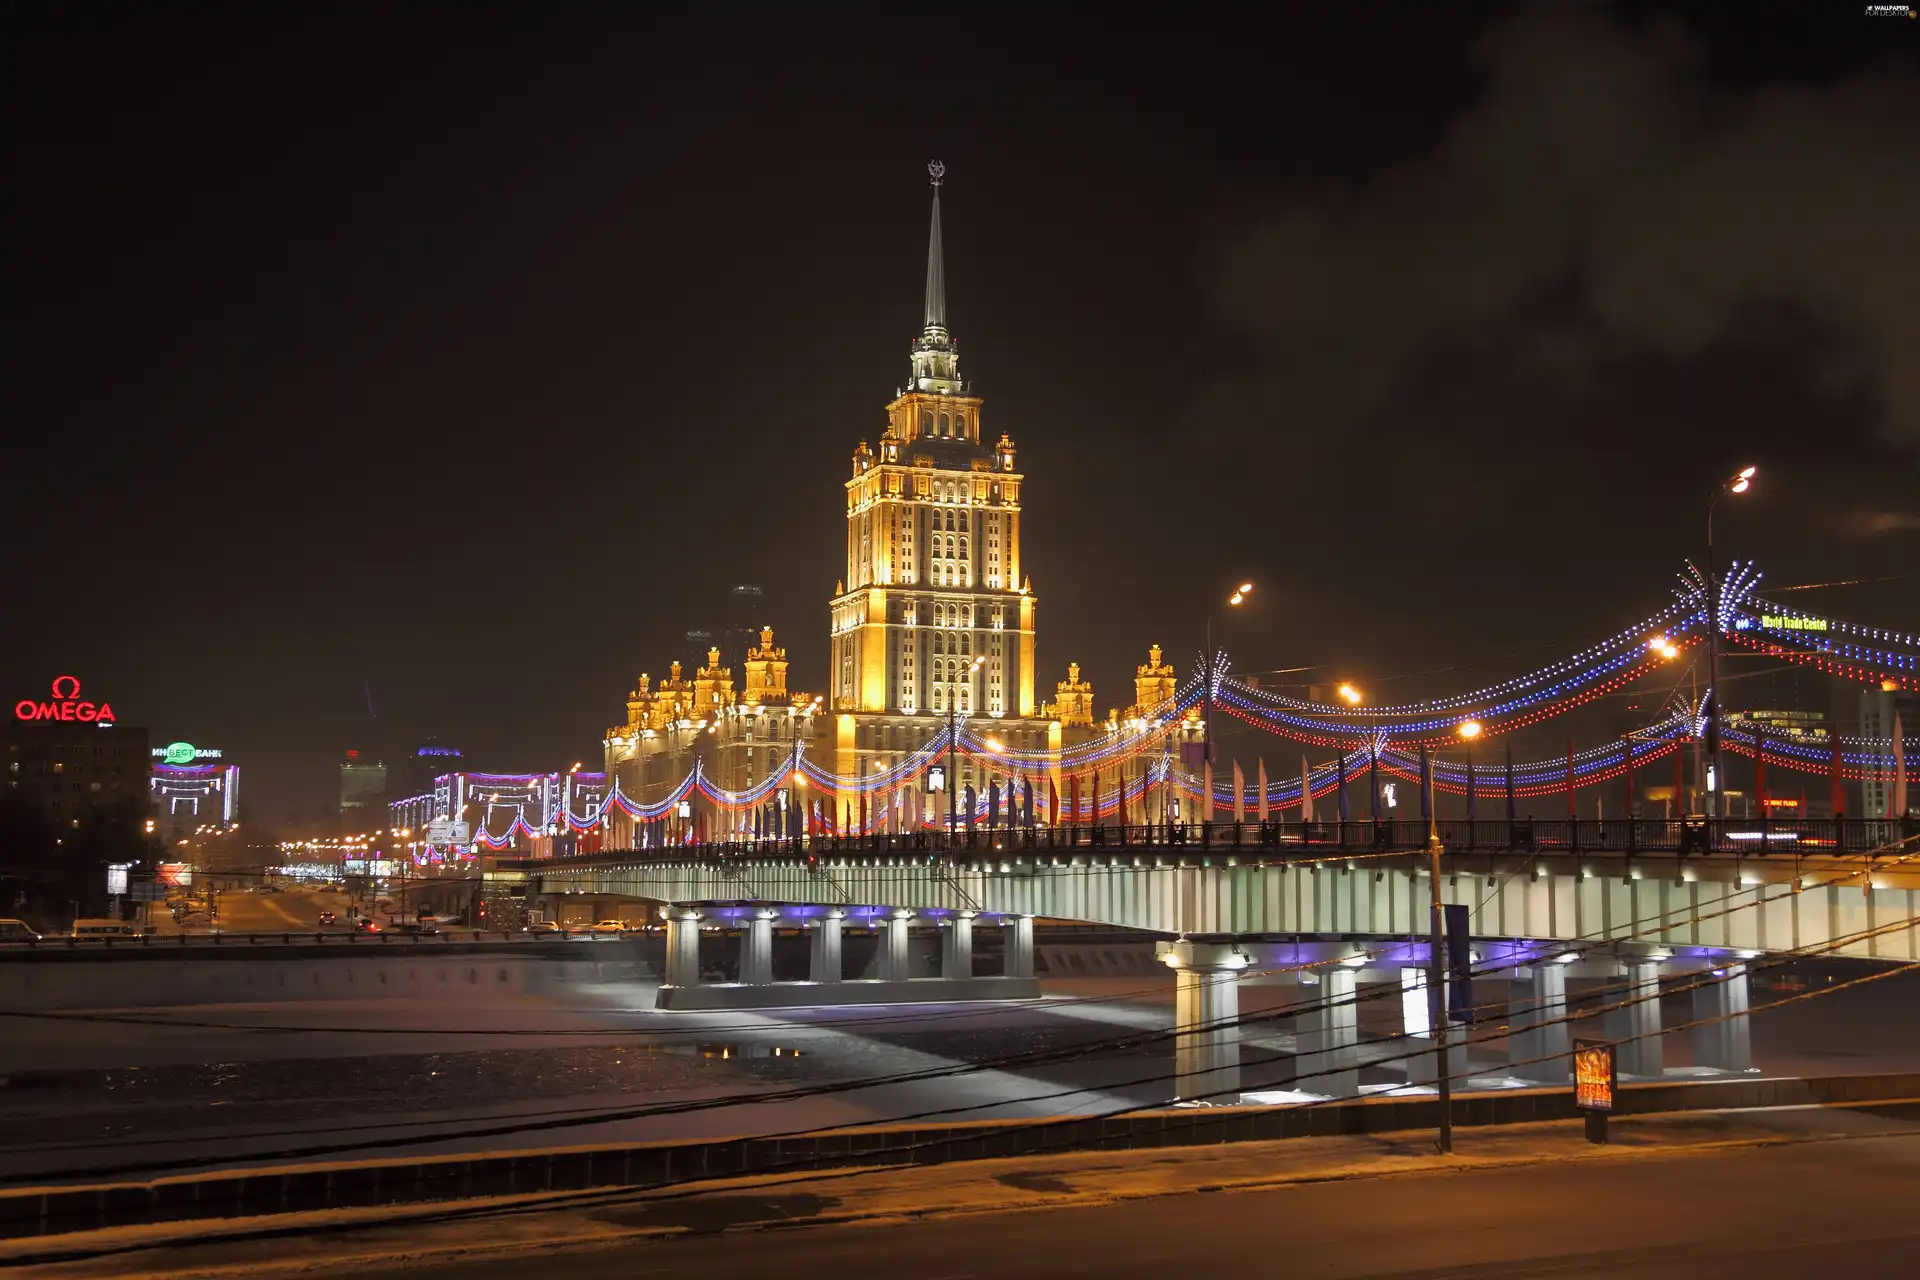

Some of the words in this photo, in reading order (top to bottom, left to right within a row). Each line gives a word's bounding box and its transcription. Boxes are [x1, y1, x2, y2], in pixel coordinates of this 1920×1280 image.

[1762, 615, 1782, 628] World
[1783, 616, 1803, 629] Trade
[1803, 618, 1827, 630] Center
[15, 700, 117, 722] OMEGA
